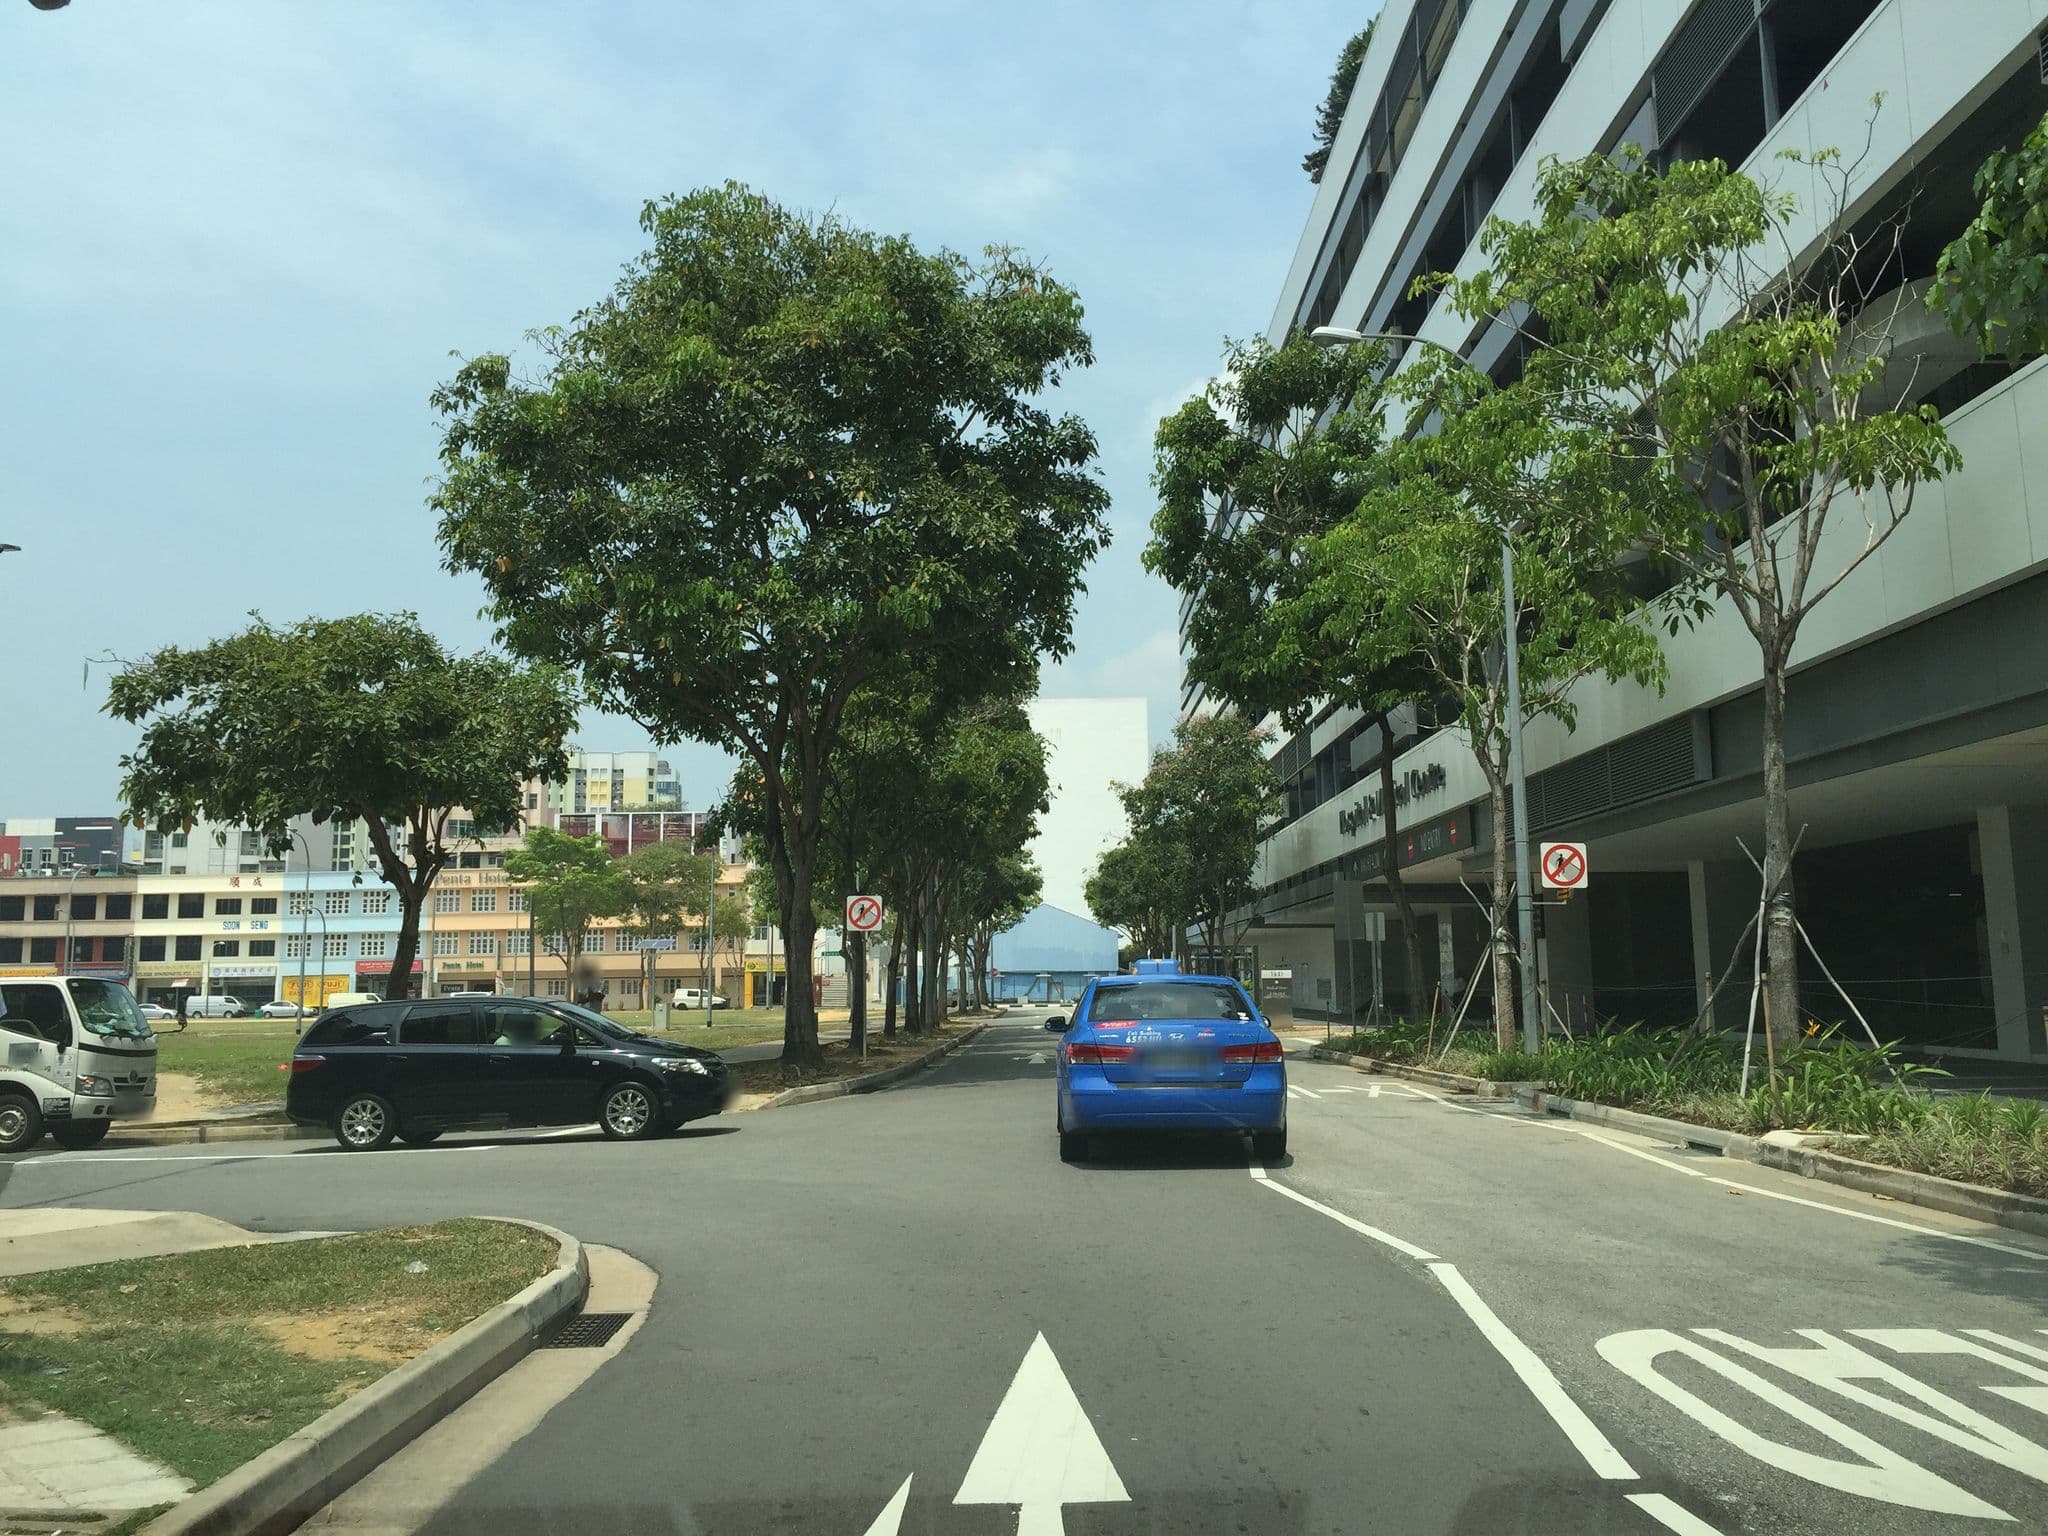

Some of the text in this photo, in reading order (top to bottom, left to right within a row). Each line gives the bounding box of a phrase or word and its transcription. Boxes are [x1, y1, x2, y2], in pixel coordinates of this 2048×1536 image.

[479, 872, 511, 884] Hote
[223, 920, 268, 930] SOON SENG
